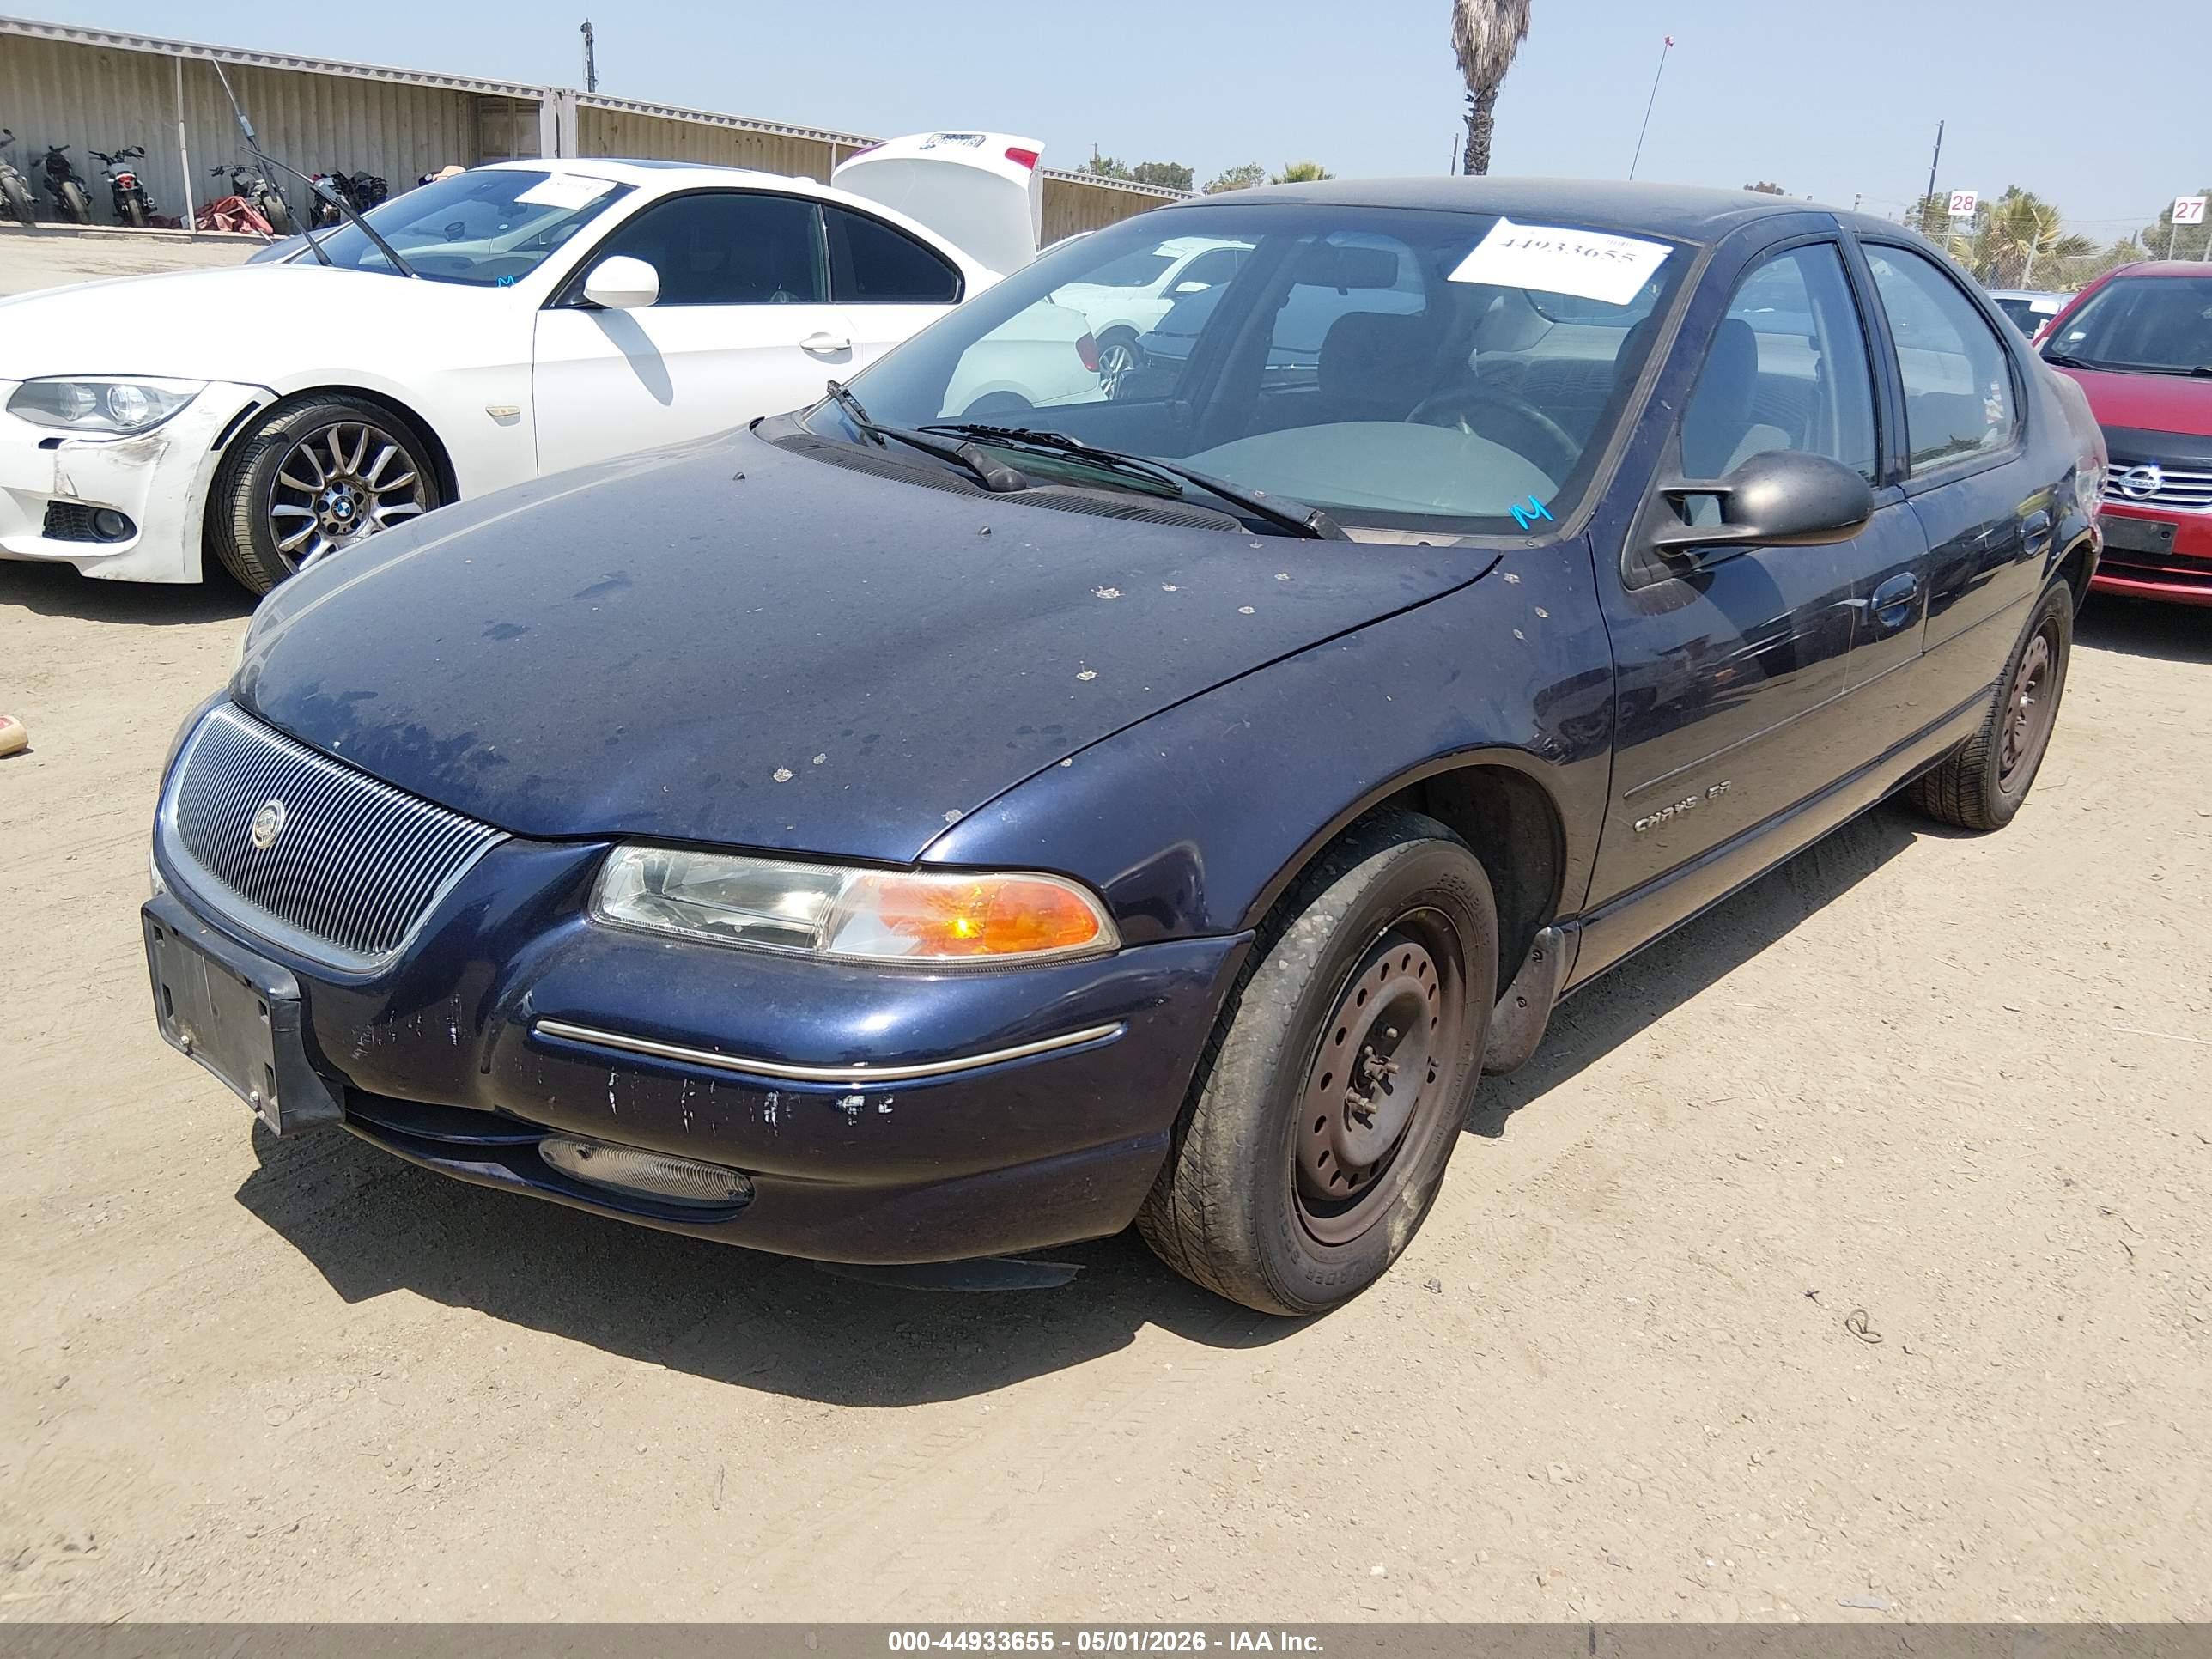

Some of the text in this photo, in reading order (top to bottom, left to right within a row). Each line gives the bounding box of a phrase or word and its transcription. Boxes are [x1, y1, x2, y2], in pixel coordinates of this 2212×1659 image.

[1951, 195, 1975, 211] 28
[2174, 202, 2203, 219] 27
[1498, 237, 1637, 264] 44933655
[2120, 478, 2158, 488] NISSAN
[1508, 495, 1554, 530] M
